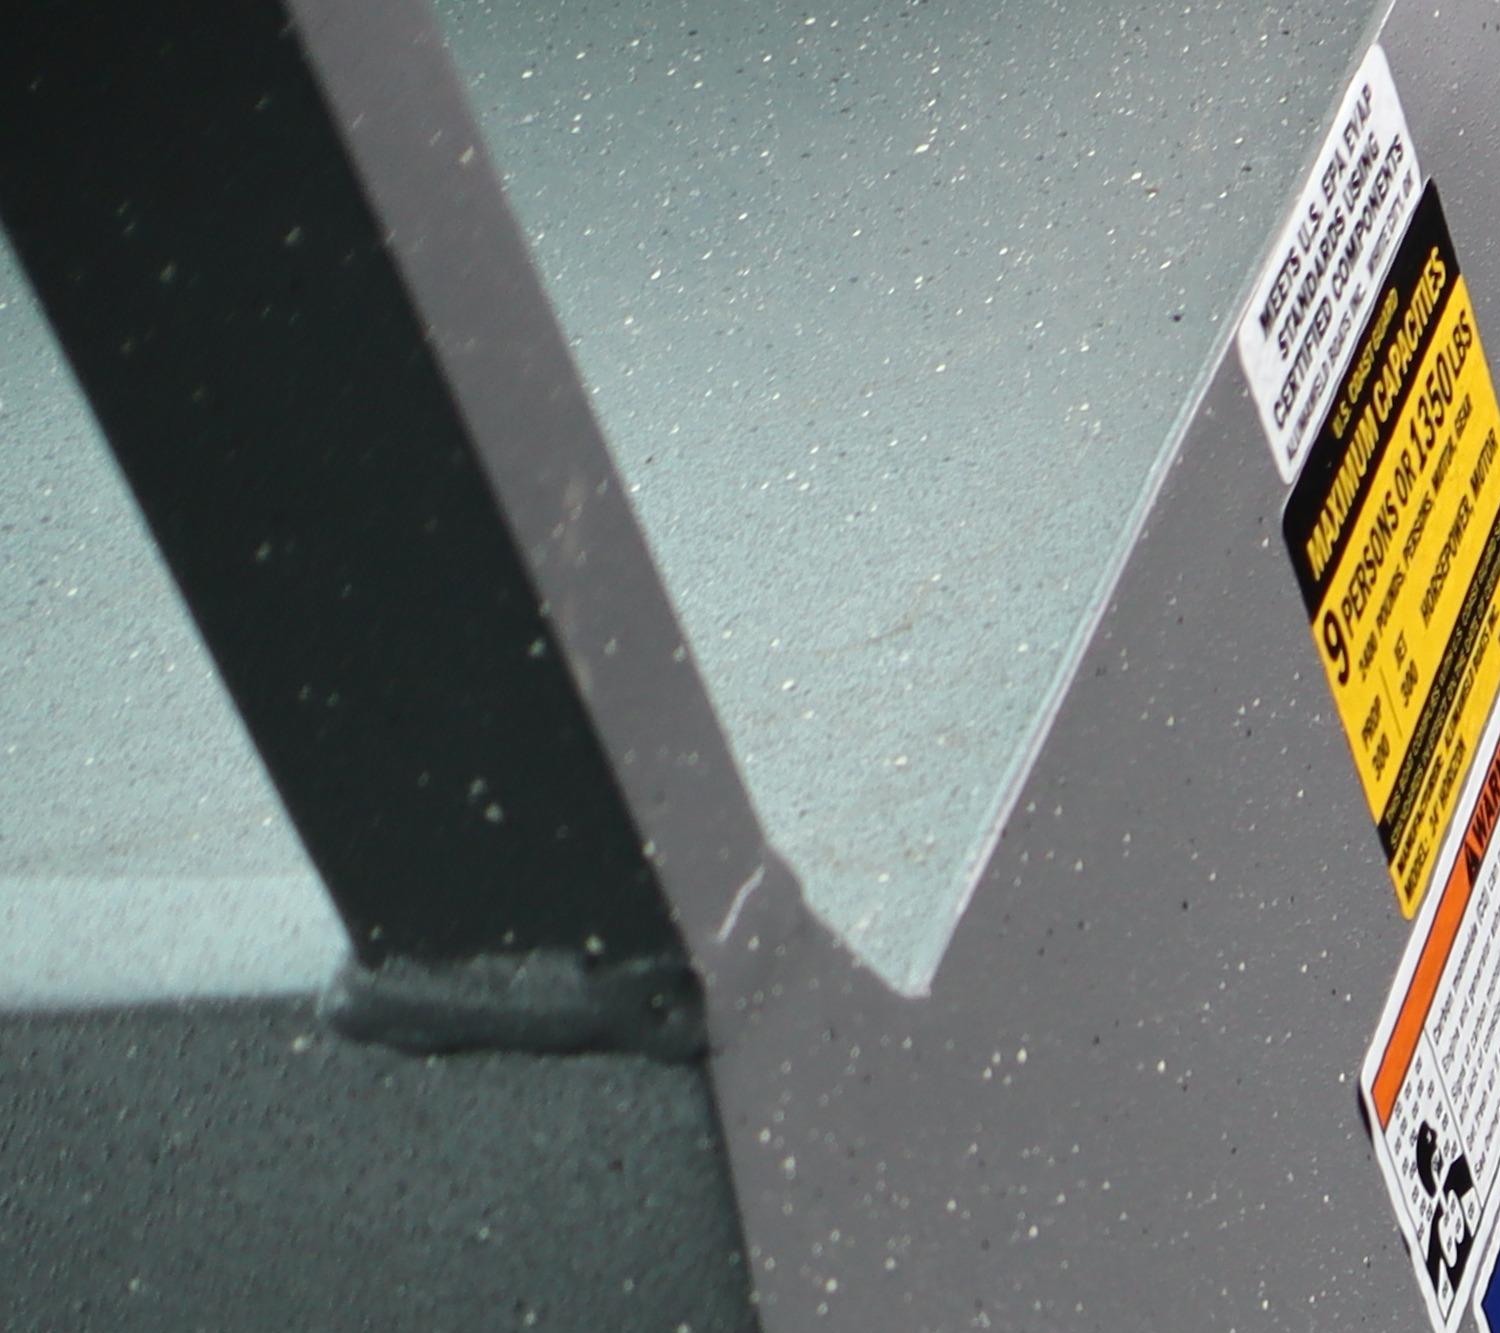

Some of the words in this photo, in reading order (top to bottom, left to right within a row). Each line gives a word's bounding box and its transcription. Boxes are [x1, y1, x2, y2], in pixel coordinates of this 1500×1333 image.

[1258, 244, 1300, 341] MEETS
[1297, 194, 1323, 255] U.S.
[1320, 143, 1347, 205] EPA
[1342, 82, 1375, 156] EVAP
[1275, 204, 1346, 362] STANDARDS
[1342, 128, 1380, 215] USING
[1272, 291, 1333, 432] CERTIFIED
[1329, 132, 1404, 301] COMPONENTS
[1306, 402, 1380, 584] MAXIMUM
[1371, 241, 1447, 427] CAPACITIES
[1332, 393, 1351, 443] U.S.
[1347, 339, 1374, 407] COAST
[1371, 283, 1399, 353] GUARD
[1454, 391, 1472, 440] GEAR
[1320, 599, 1352, 695] 9
[1340, 486, 1400, 640] PERSONS
[1392, 444, 1416, 511] OR
[1407, 348, 1454, 474] 1350
[1446, 307, 1473, 380] LBS
[1469, 425, 1497, 502] MOTOR
[1393, 628, 1407, 669] JET
[1399, 656, 1418, 708] 300
[1361, 692, 1383, 751] PROP
[1371, 729, 1390, 782] 300
